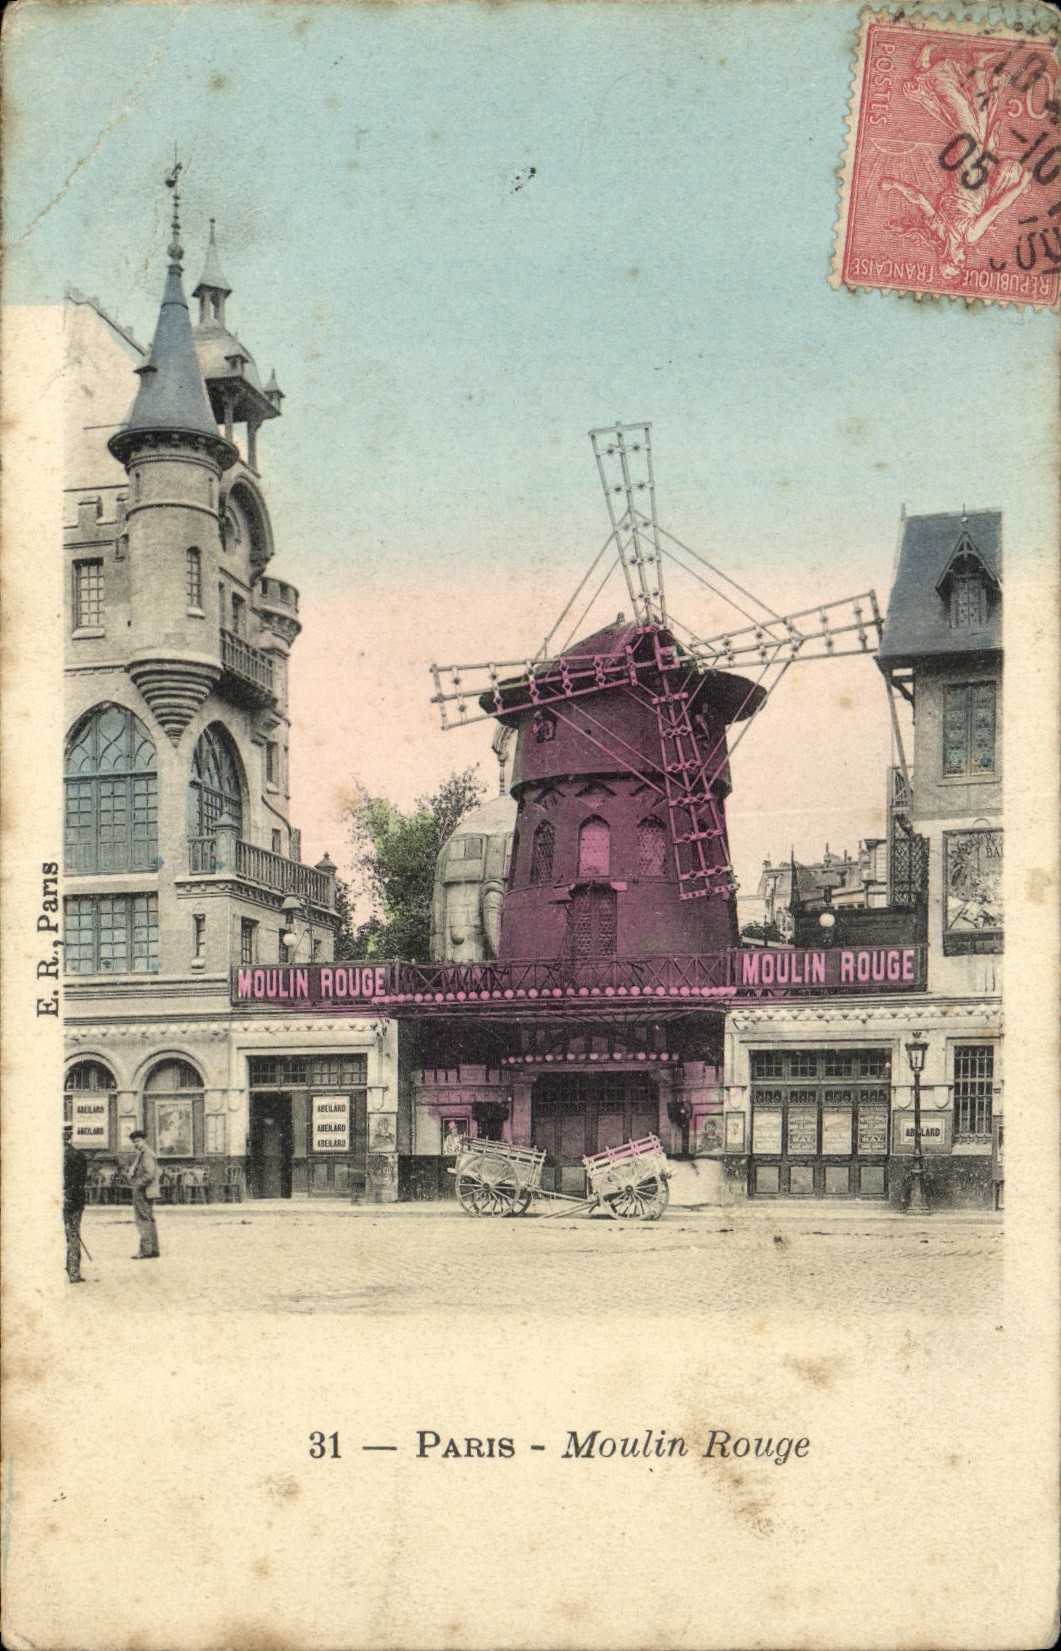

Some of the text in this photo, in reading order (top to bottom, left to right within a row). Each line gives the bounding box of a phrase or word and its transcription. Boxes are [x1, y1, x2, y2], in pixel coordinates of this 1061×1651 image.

[869, 41, 896, 126] POSTES
[937, 132, 999, 190] 05
[237, 967, 386, 998] MOULIN ROUGE
[742, 949, 914, 985] MOULIN ROUGE
[905, 1127, 940, 1137] ABLARD
